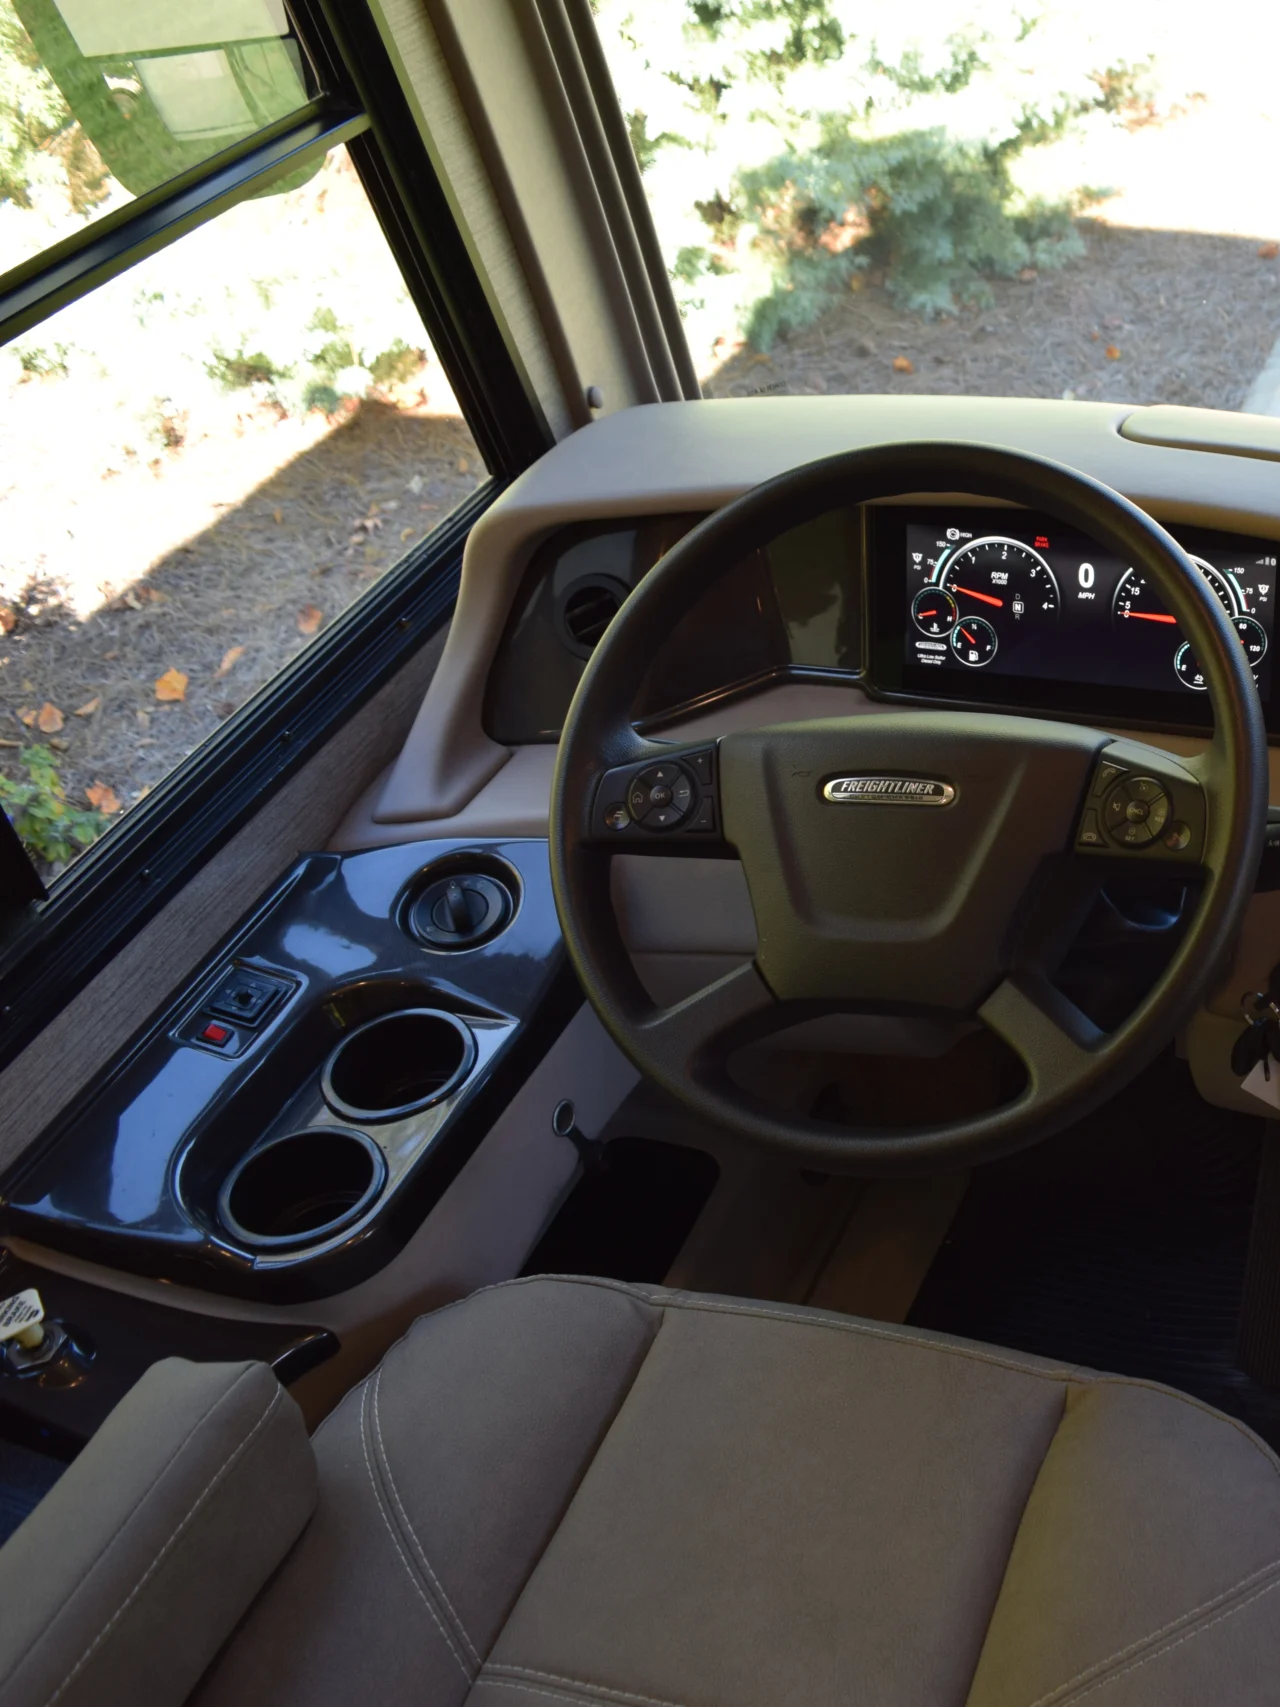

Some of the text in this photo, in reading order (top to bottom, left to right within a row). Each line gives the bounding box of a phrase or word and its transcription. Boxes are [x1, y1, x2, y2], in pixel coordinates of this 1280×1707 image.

[936, 540, 946, 548] 150
[1001, 551, 1008, 560] 2
[1029, 568, 1037, 578] 3
[1078, 562, 1095, 589] 0
[1234, 567, 1245, 575] 150
[991, 571, 1008, 581] RPM
[1078, 591, 1096, 600] MPH
[1131, 586, 1141, 596] 15
[1015, 593, 1021, 601] D
[1042, 602, 1048, 611] 4
[1125, 600, 1132, 609] 5
[840, 780, 935, 795] FREIGHTLINER
[654, 792, 666, 800] OK
